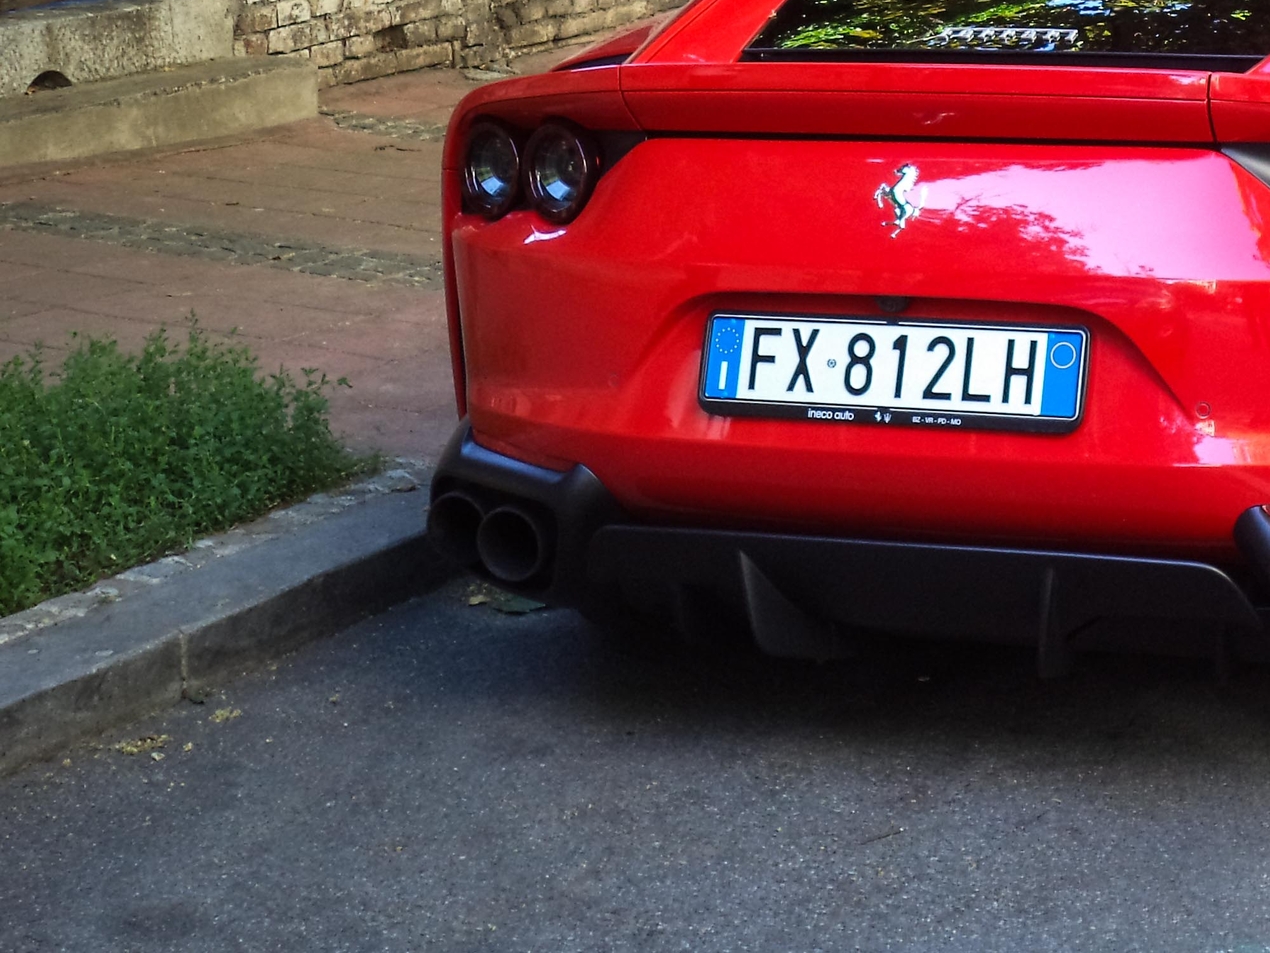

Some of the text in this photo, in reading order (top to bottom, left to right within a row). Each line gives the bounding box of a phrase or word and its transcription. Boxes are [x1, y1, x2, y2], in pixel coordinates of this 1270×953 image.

[843, 332, 1039, 406] 812LH
[807, 407, 854, 421] ineco auto
